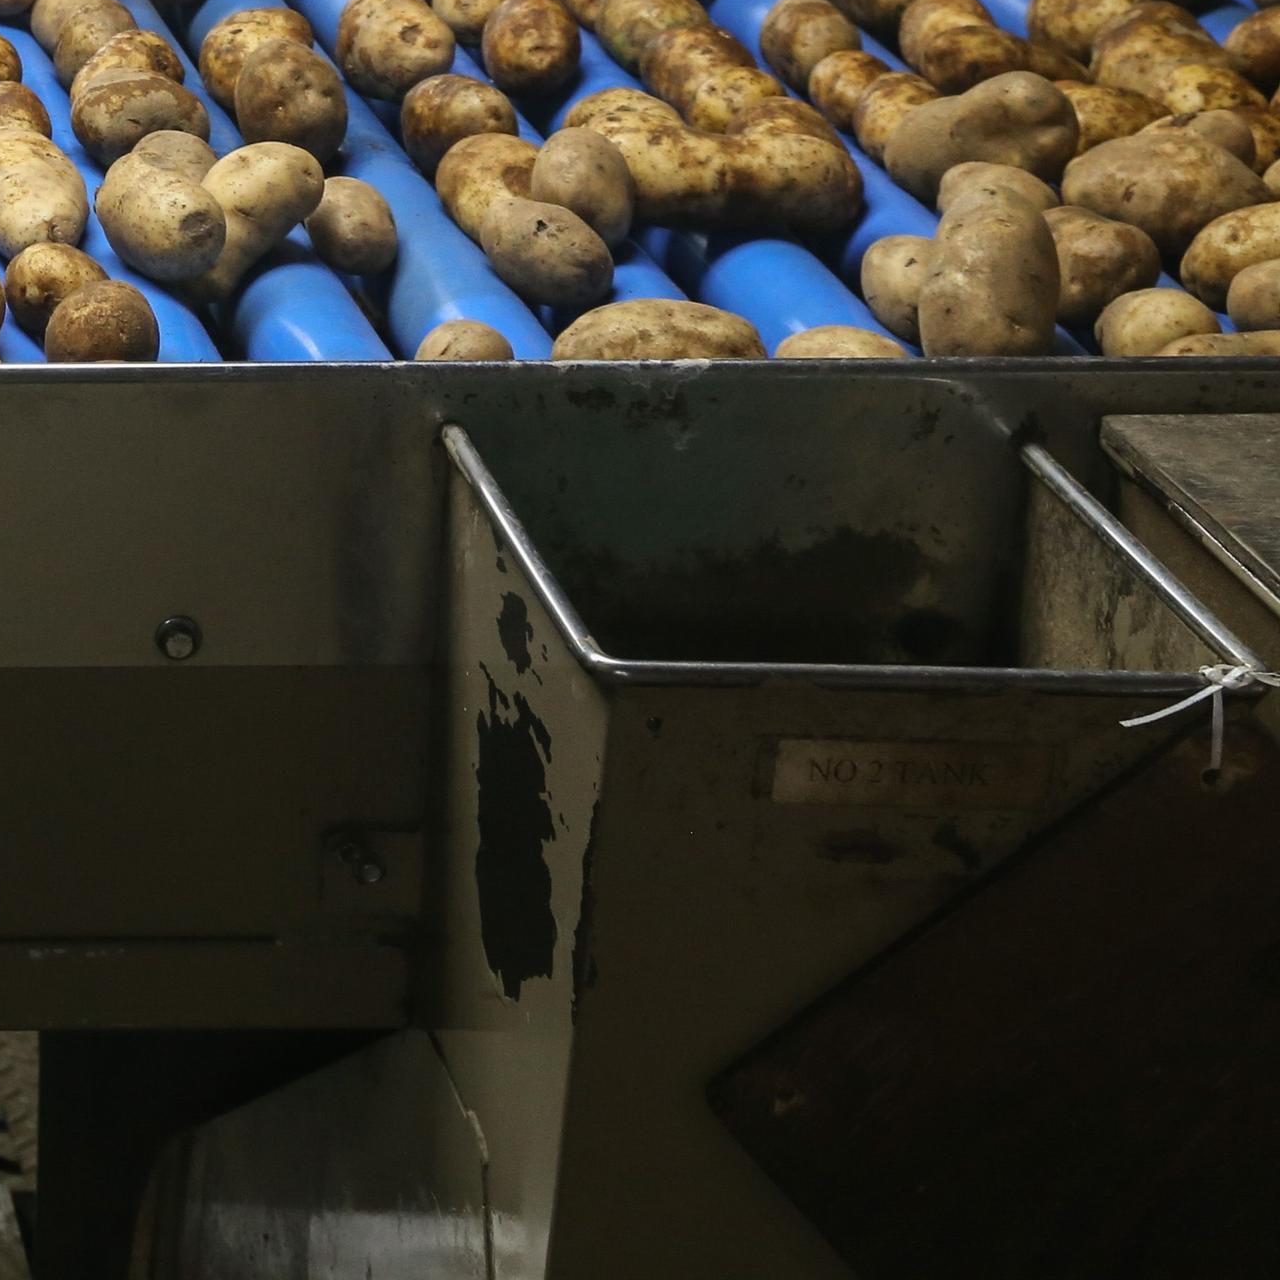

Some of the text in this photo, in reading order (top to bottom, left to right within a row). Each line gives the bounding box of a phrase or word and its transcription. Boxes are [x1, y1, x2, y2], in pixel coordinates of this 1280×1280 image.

[808, 757, 991, 787] NO 2 TANK
